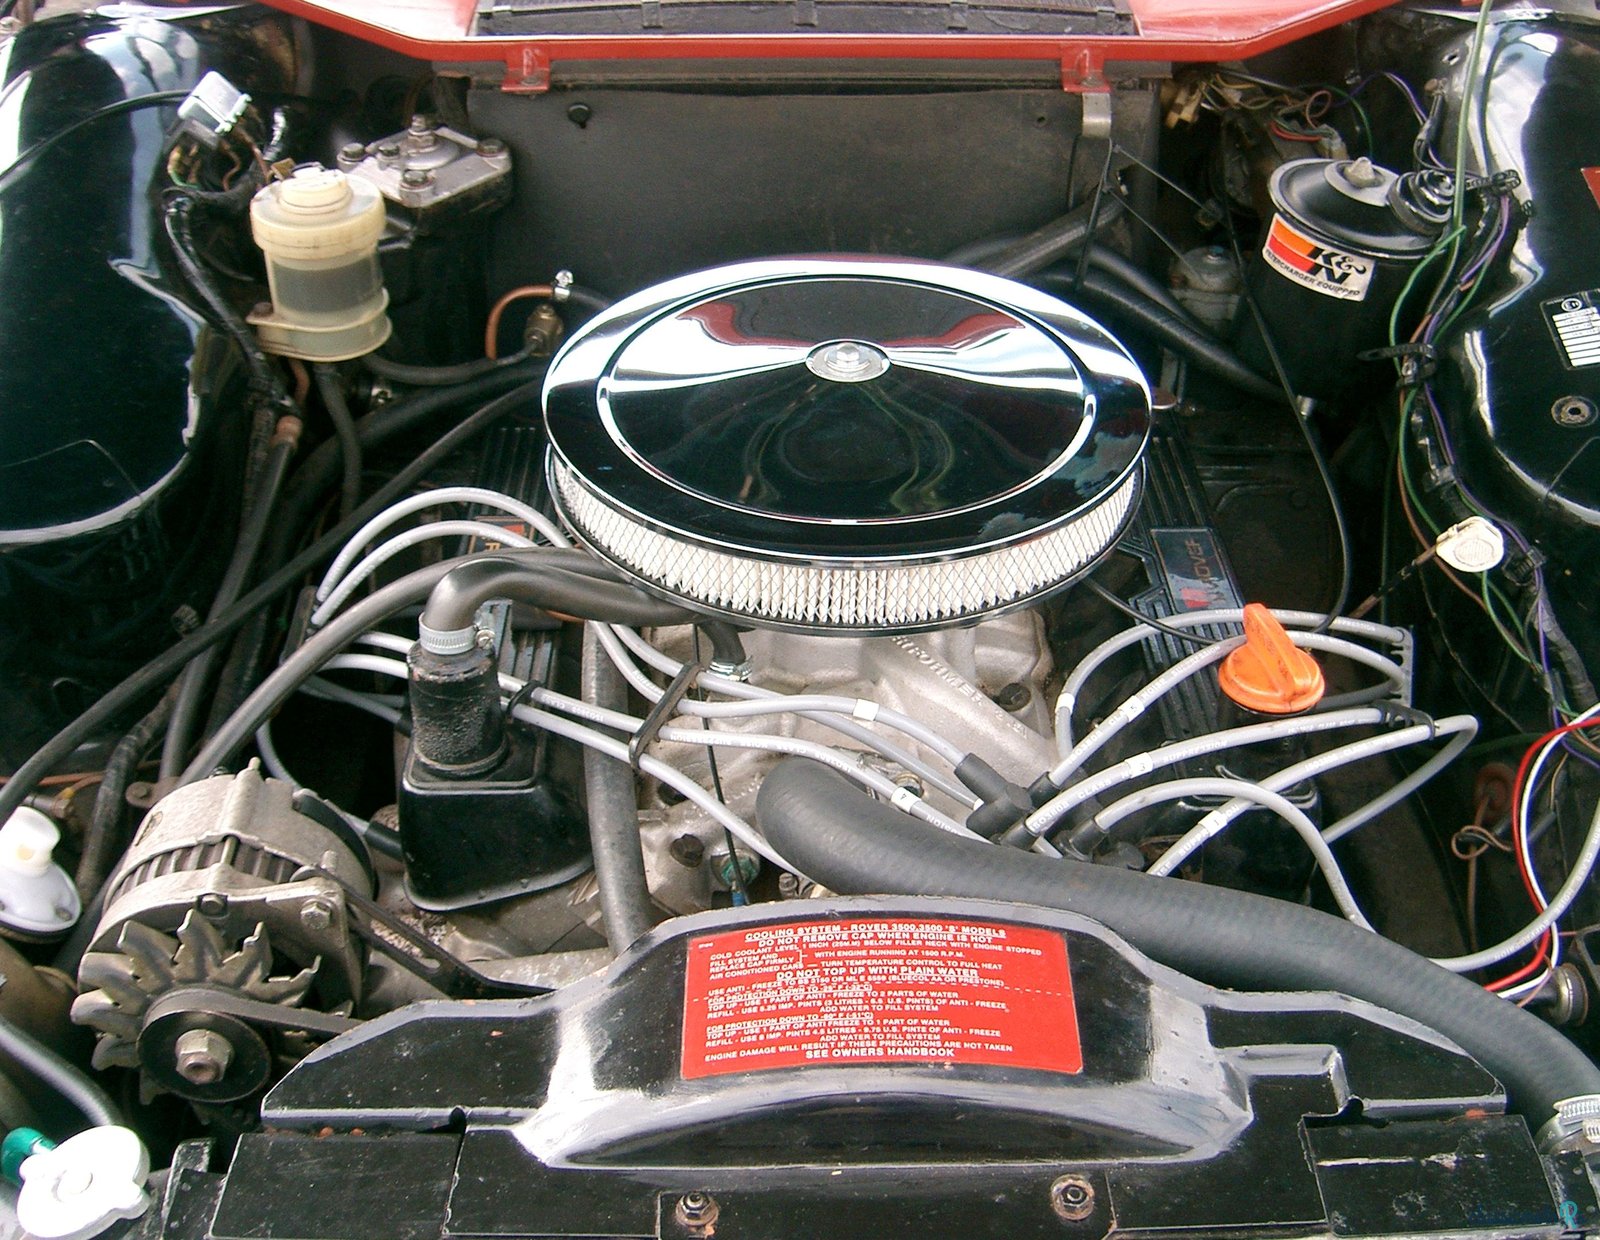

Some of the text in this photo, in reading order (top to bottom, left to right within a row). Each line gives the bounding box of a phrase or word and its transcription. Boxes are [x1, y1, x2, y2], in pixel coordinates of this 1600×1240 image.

[745, 928, 794, 940] COOLING
[797, 925, 841, 935] SYSTEM
[962, 926, 1006, 937] MODELS
[759, 939, 774, 947] DO
[777, 937, 800, 945] NOT
[802, 933, 848, 943] REMOVE
[852, 932, 874, 940] CAP
[913, 933, 953, 941] ENGINE
[957, 934, 968, 942] IS
[970, 935, 993, 943] HOT
[710, 952, 732, 961] COLD
[734, 947, 772, 957] COOLANT
[774, 944, 799, 952] LEVEL
[808, 941, 829, 949] INCH
[973, 943, 1003, 951] ENGINE
[1006, 946, 1041, 956] STOPPED
[837, 949, 868, 957] ENGINE
[710, 964, 745, 973] REPLACE
[765, 957, 794, 966] FIRMLY
[728, 955, 759, 965] SYSTEM
[725, 966, 780, 978] CONDITIONED
[782, 962, 804, 970] CARS
[776, 971, 793, 980] DO
[796, 969, 820, 977] NOT
[823, 967, 847, 975] TOP
[868, 966, 898, 974] WITH
[901, 966, 935, 974] PLAIN
[937, 967, 978, 977] WATER
[708, 988, 724, 996] USE
[752, 982, 782, 990] FREEZE
[726, 991, 778, 1002] PROTECTION
[780, 987, 805, 996] DOWN
[707, 1010, 734, 1019] REFILL
[975, 1000, 1006, 1009] FREEZE
[706, 1025, 723, 1033] FOR
[725, 1018, 777, 1029] PROTECTION
[779, 1015, 805, 1024] DOWN
[705, 1039, 733, 1047] REFILL
[786, 1029, 810, 1037] PINTS
[969, 1028, 1001, 1037] FREEZE
[705, 1051, 737, 1061] ENGINE
[740, 1046, 776, 1057] DAMAGE
[779, 1044, 799, 1052] WILL
[801, 1041, 835, 1050] RESULT
[984, 1043, 1013, 1051] TAKEN
[805, 1047, 954, 1058] SEE OWNERS HANDBOOK
